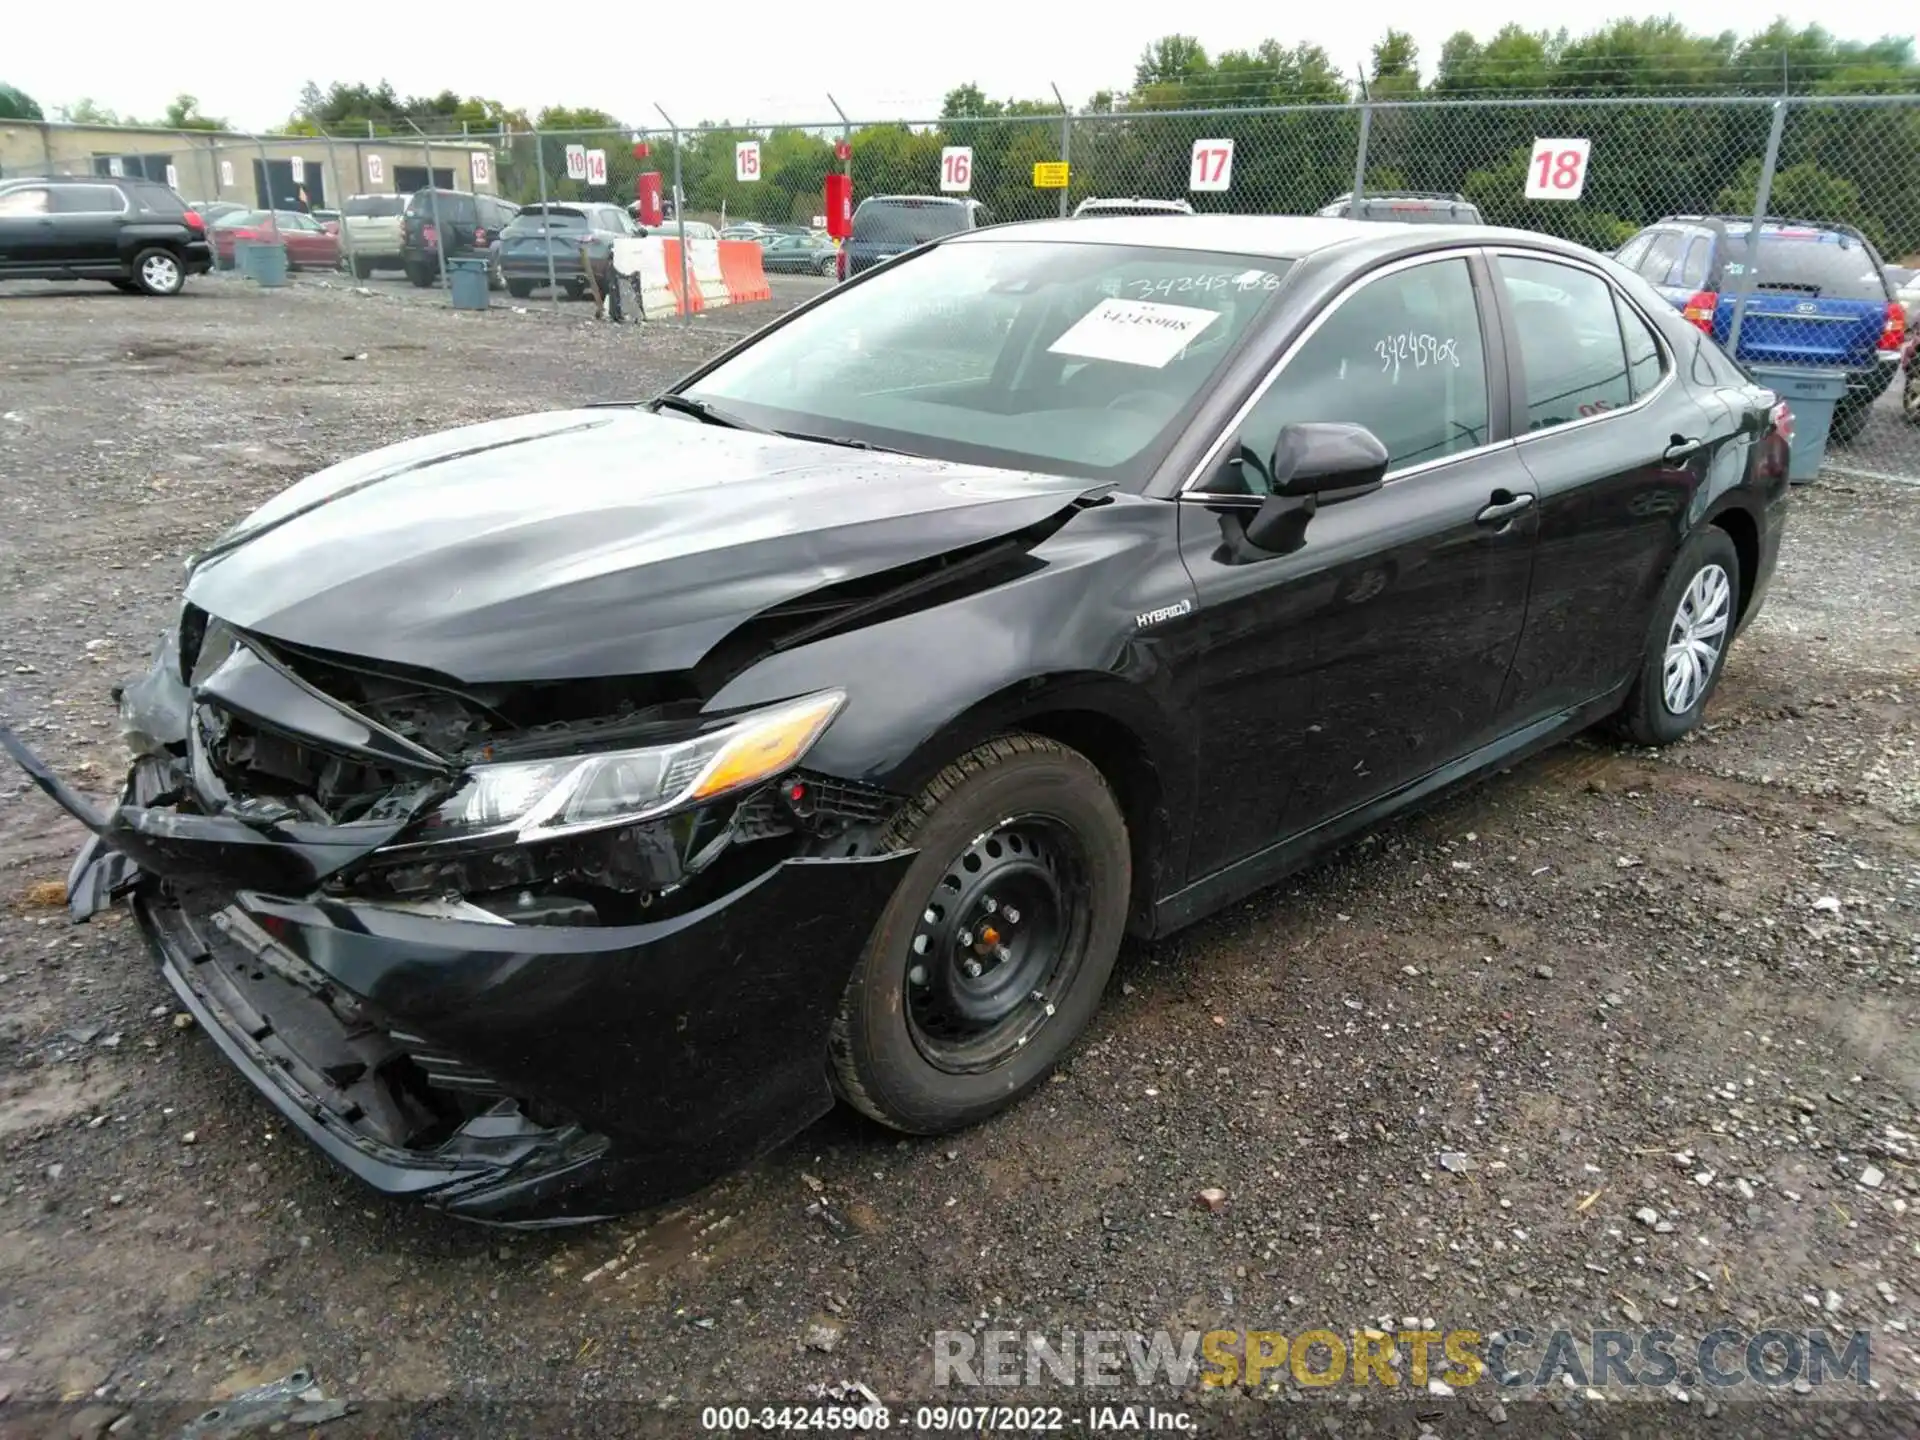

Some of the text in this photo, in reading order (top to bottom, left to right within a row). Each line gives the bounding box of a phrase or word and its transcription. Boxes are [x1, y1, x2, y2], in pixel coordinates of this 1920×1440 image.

[369, 159, 381, 179] 12
[473, 159, 487, 179] 13
[568, 152, 584, 171] 10
[588, 157, 604, 178] 14
[738, 150, 757, 175] 15
[944, 155, 969, 184] 16
[1196, 150, 1228, 182] 17
[1536, 151, 1581, 189] 18
[1127, 272, 1281, 299] 34245908
[1374, 330, 1461, 384] 34245908
[1136, 603, 1182, 628] HYBRID
